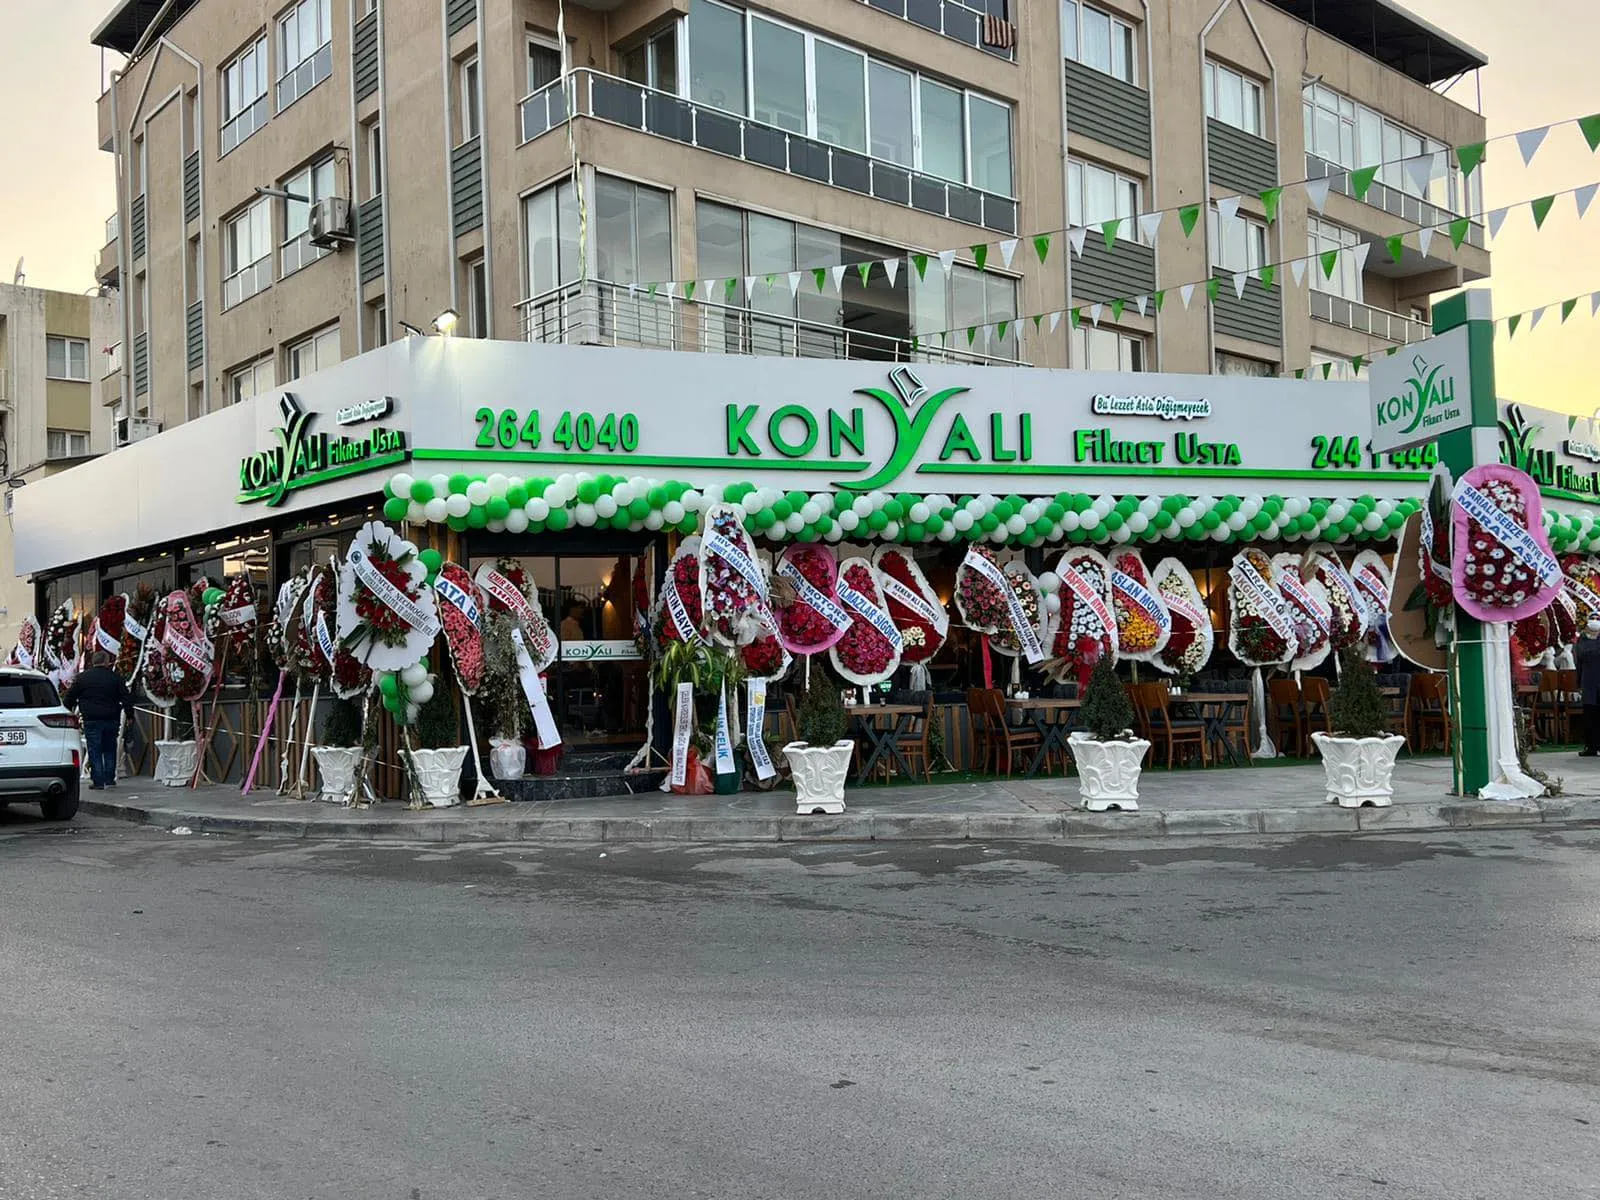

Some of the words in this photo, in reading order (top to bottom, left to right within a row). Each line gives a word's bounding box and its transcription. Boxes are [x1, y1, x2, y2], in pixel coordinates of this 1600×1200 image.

[1110, 398, 1134, 411] Lezzet
[1377, 364, 1454, 433] KONYALI
[476, 408, 542, 449] 264
[553, 412, 640, 452] 4040
[726, 387, 1032, 491] KONYALI
[239, 412, 328, 507] KONYALI
[1311, 435, 1361, 468] 244
[1457, 495, 1513, 542] MURAT
[1512, 545, 1549, 581] ASAN
[1495, 511, 1522, 539] SEBZE
[436, 580, 467, 609] ATA
[785, 563, 805, 588] KRAL
[805, 585, 848, 622] MOTORS
[802, 591, 842, 627] TARLAK
[836, 581, 878, 620] YILMAZLAR
[1140, 588, 1169, 629] MOTORS
[178, 647, 206, 671] TURAN
[7, 732, 24, 741] 968
